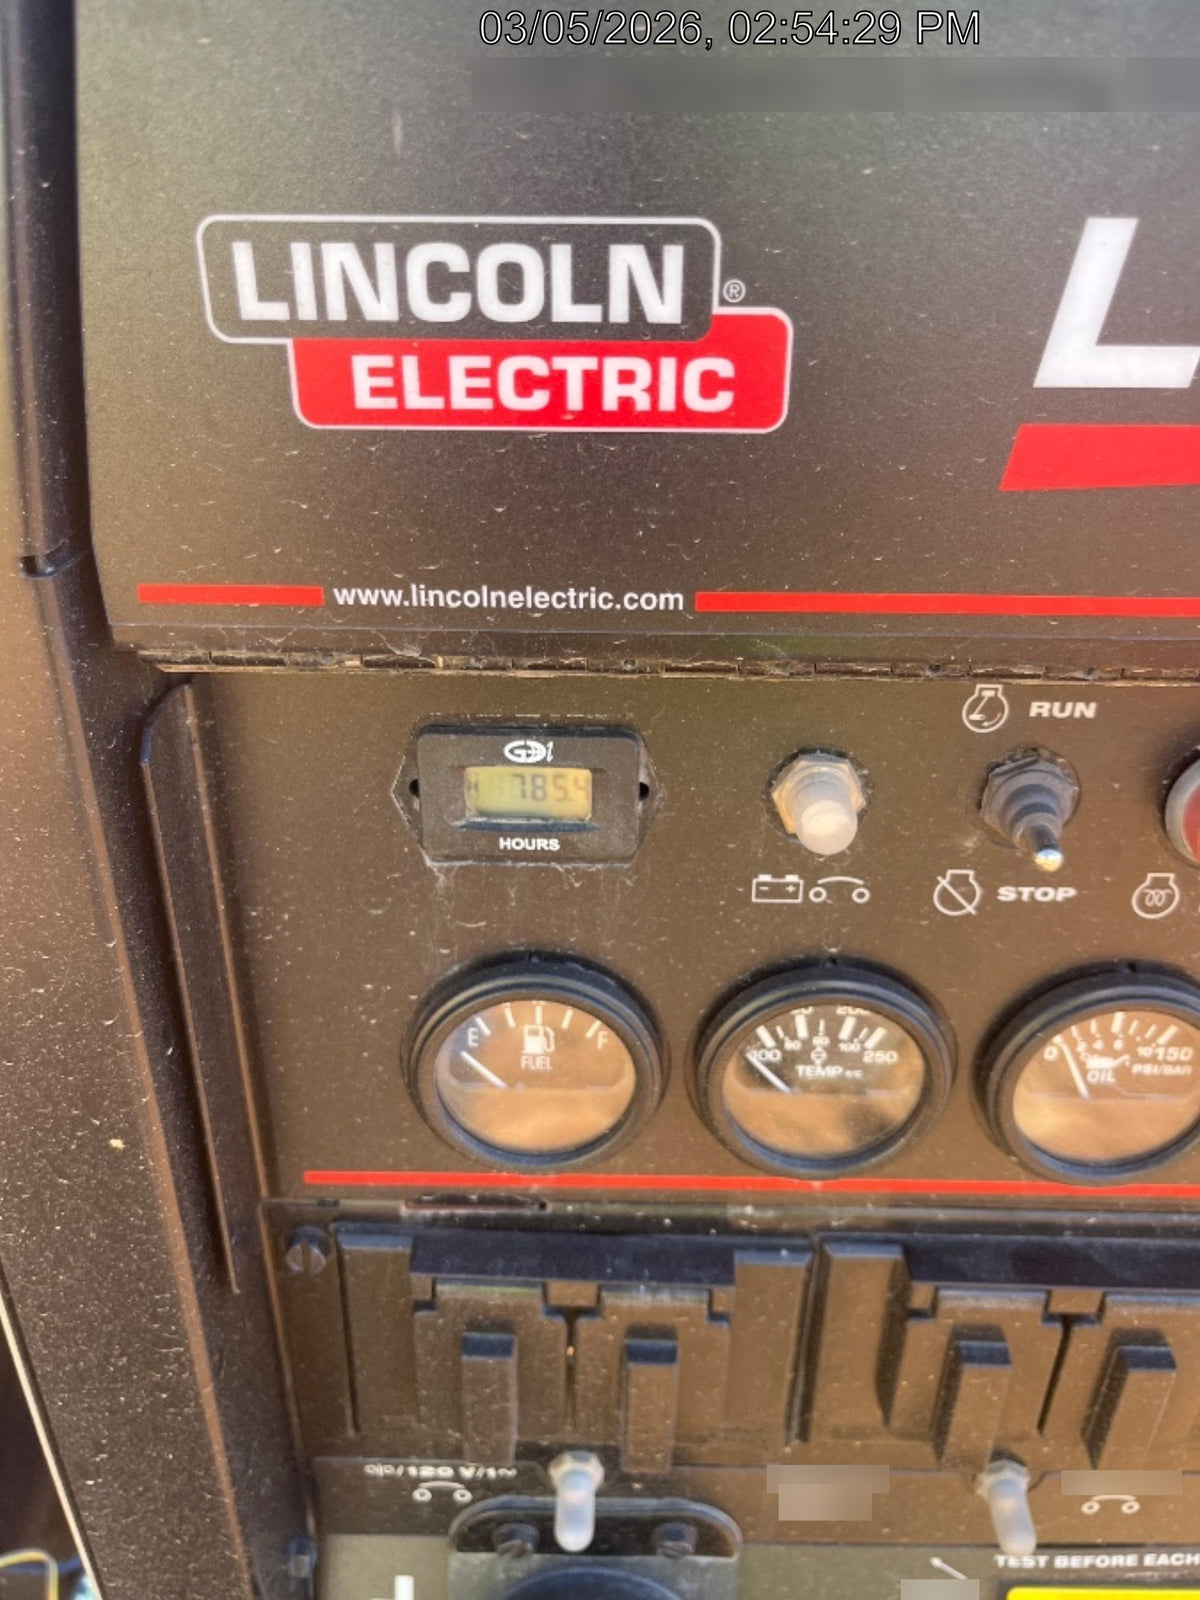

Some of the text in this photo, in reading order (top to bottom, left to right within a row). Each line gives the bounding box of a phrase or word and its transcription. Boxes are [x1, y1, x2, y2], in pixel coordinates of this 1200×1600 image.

[232, 241, 684, 325] LINCOLN
[1033, 217, 1200, 388] L
[351, 354, 735, 412] ELECTRIC
[333, 583, 685, 611] www.lincolnelectric.com
[1029, 701, 1097, 719] RUN
[498, 837, 561, 851] HOURS
[996, 886, 1077, 903] STOP
[467, 1027, 609, 1050] E F
[863, 1050, 899, 1064] 250
[1043, 1045, 1059, 1061] 0
[1156, 1046, 1194, 1062] 150
[521, 1055, 553, 1070] FUEL
[1131, 1064, 1193, 1076] PSI/BAR
[795, 1064, 844, 1079] TEMP
[1086, 1069, 1116, 1083] OIL
[995, 1553, 1200, 1569] TEST BEFORE EACH
